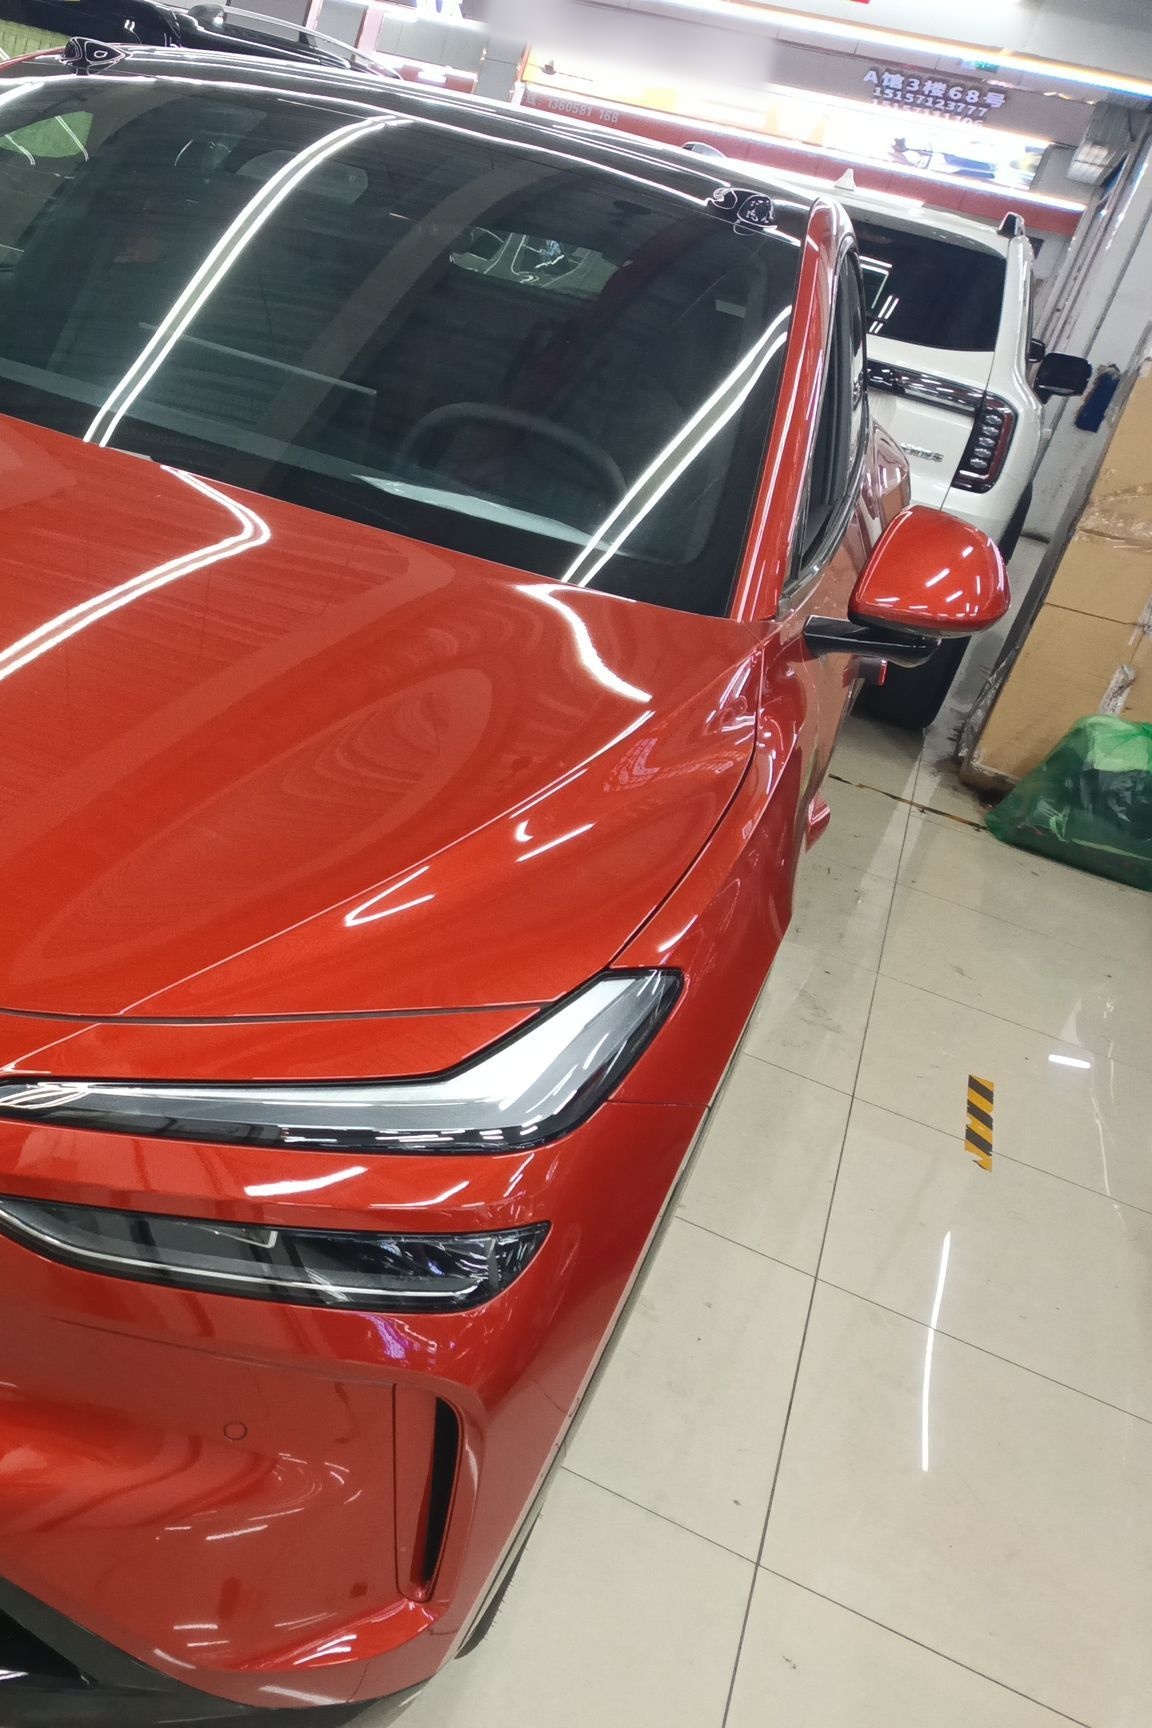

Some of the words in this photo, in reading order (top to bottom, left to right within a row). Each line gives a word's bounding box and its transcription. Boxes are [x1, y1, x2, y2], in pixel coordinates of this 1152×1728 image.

[863, 70, 1006, 108] A馆3楼68号
[872, 86, 989, 117] 15157123777
